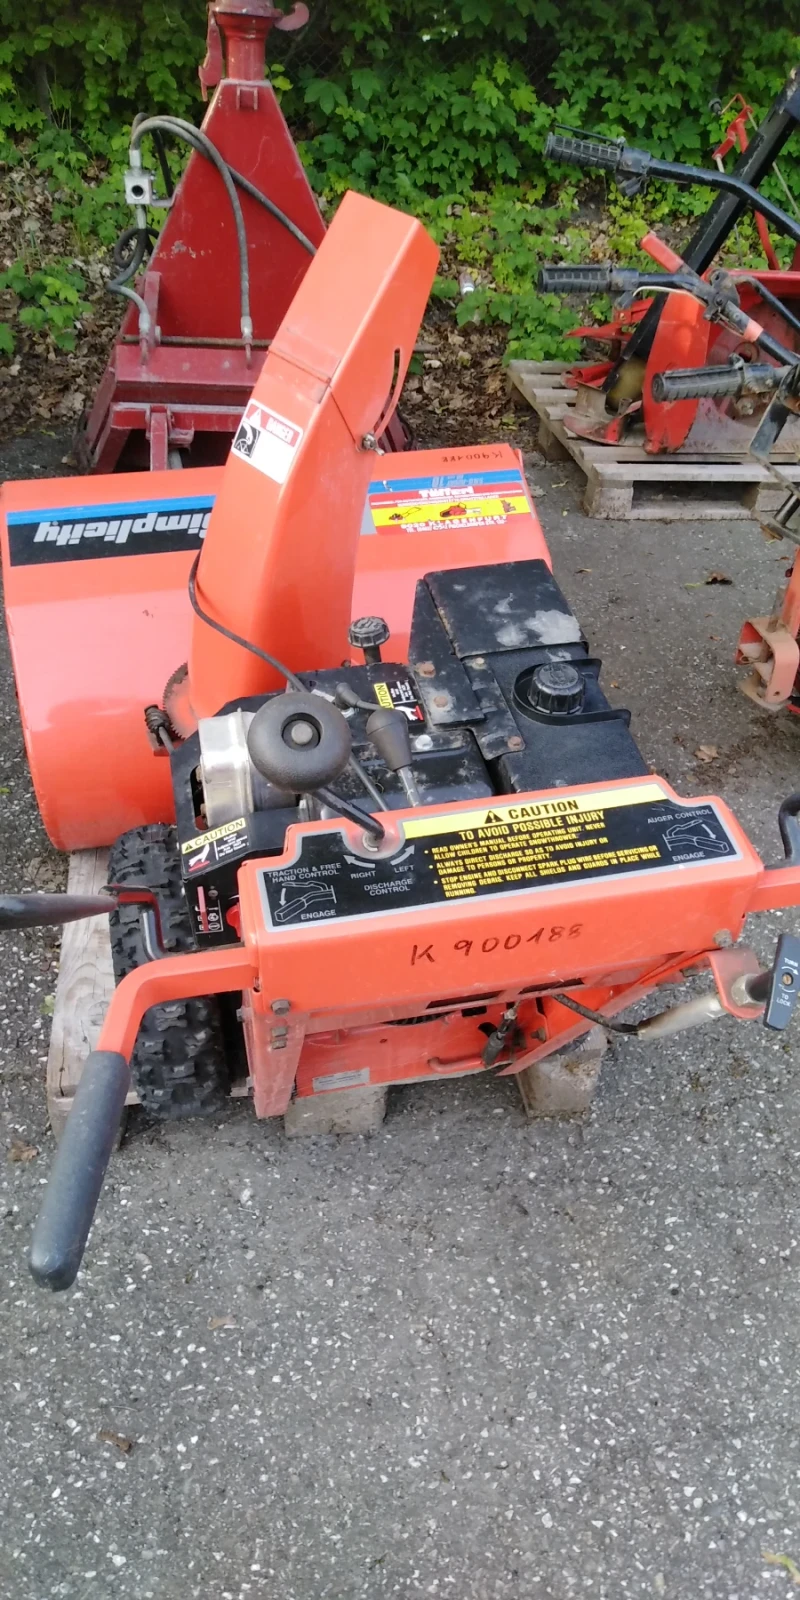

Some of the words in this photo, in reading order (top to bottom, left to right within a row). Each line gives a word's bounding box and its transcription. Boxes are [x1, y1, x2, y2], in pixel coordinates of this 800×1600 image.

[376, 684, 392, 708] UTION
[508, 800, 580, 820] CAUTION
[647, 814, 674, 824] AUGER
[675, 809, 713, 819] CONTROL
[194, 820, 243, 846] CAUTION
[459, 830, 474, 841] TO
[478, 825, 510, 837] AVOID
[512, 817, 564, 833] POSSIBLE
[566, 810, 605, 824] INJURY
[431, 846, 448, 854] READ
[450, 842, 478, 851] OWNER'S
[479, 838, 505, 847] MANUAL
[507, 834, 531, 842] BEFORE
[532, 828, 566, 839] OPERATING
[585, 822, 606, 830] NEVER
[434, 852, 455, 860] ALLOW
[457, 847, 488, 857] CHILDREN
[500, 842, 527, 850] OPERATE
[436, 859, 463, 869] ALWAYS
[465, 856, 486, 864] DIRECT
[488, 850, 523, 862] DISCHARGE
[555, 842, 574, 851] AVOID
[575, 839, 598, 848] INJURY
[672, 851, 706, 862] ENGAGE
[268, 866, 310, 878] TRACTION
[320, 862, 341, 870] FREE
[394, 865, 415, 873] LEFT
[438, 866, 465, 875] DAMAGE
[477, 860, 506, 870] PERSONS
[441, 876, 458, 884] STOP
[459, 873, 483, 881] ENGINE
[484, 870, 497, 878] AND
[498, 864, 536, 875] DISCONNECT
[538, 861, 559, 870] SPARK
[560, 858, 576, 866] PLUG
[576, 854, 593, 863] WIRE
[593, 851, 616, 861] BEFORE
[616, 847, 649, 858] SERVICING
[443, 880, 477, 891] REMOVING
[525, 871, 537, 879] ALL
[539, 866, 566, 876] SHIELDS
[568, 863, 582, 872] AND
[583, 860, 609, 870] GUARDS
[620, 854, 640, 864] PLACE
[640, 851, 661, 860] WHILE
[299, 869, 339, 880] CONTROL
[350, 870, 376, 879] RIGHT
[364, 878, 413, 891] DISCHARGE
[369, 886, 410, 896] CONTROL
[301, 909, 336, 920] ENGAGE
[410, 944, 435, 966] K
[776, 997, 791, 1007] LOCK
